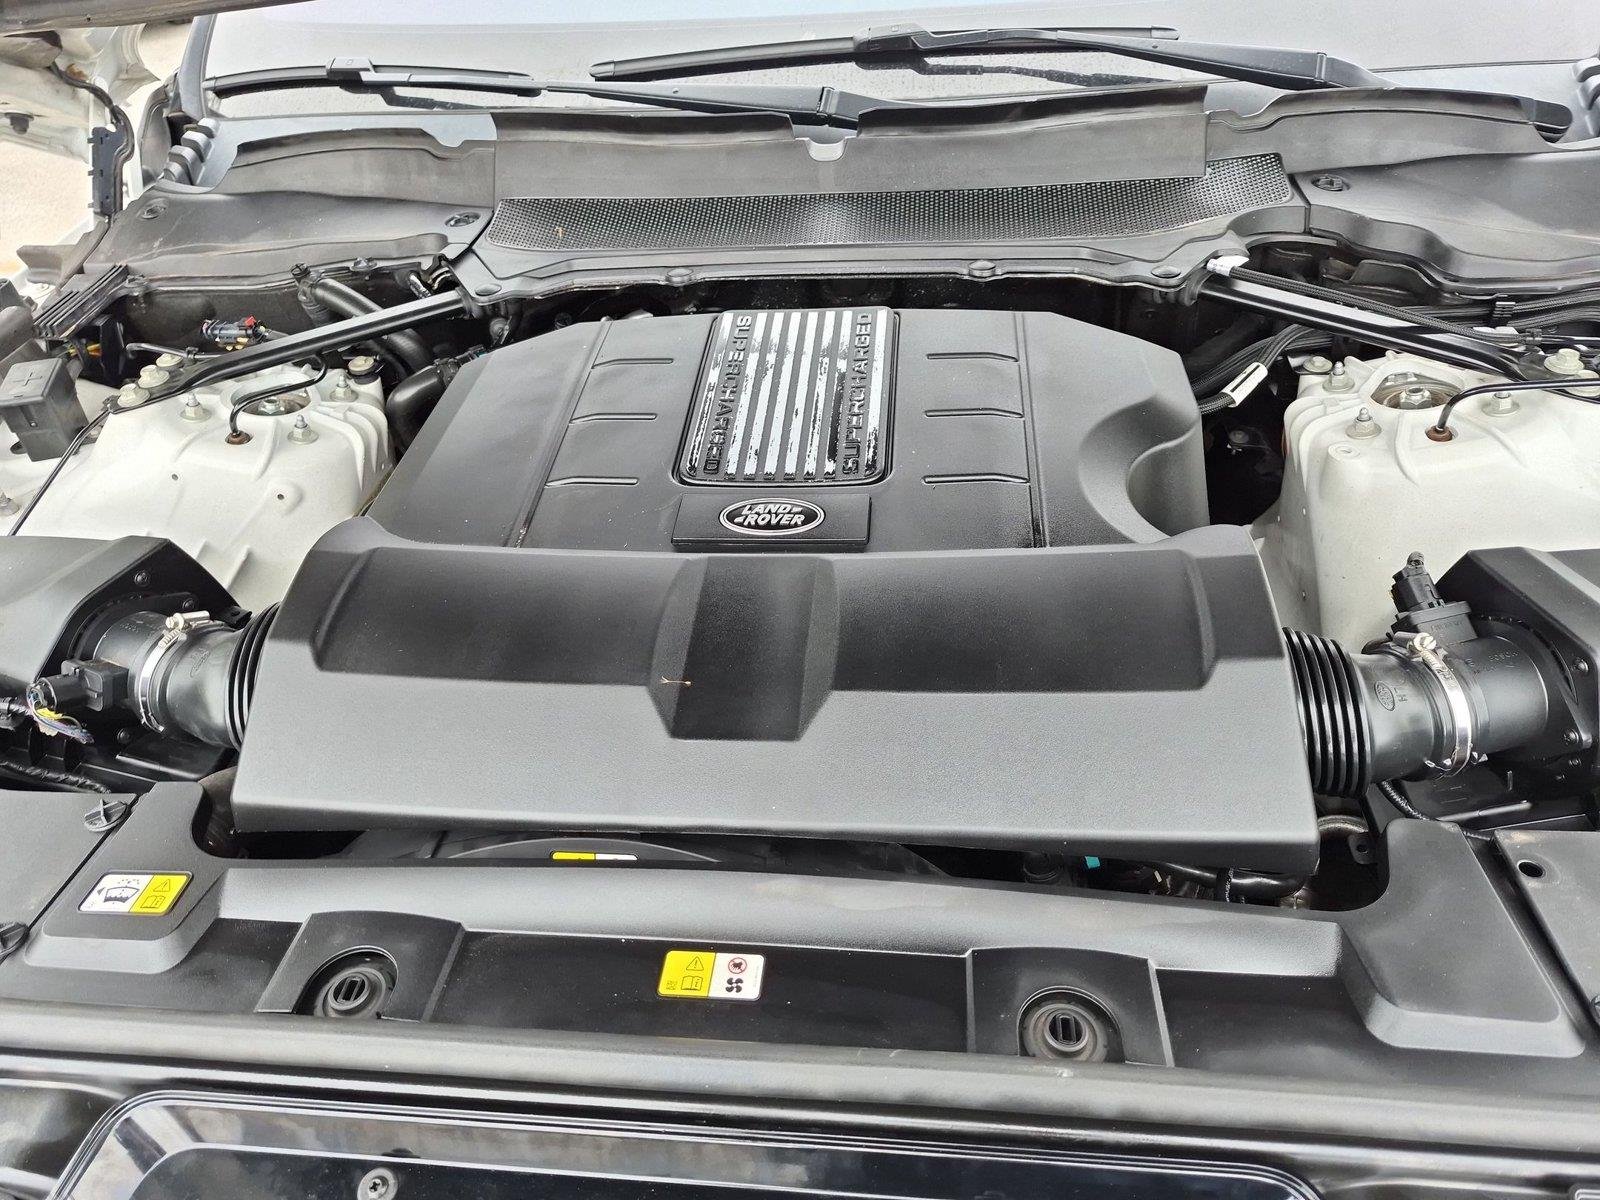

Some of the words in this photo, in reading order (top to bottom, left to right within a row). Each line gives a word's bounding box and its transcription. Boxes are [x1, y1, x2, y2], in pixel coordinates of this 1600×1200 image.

[703, 315, 751, 475] SUPERCHARGED
[842, 312, 872, 475] SUPERCHARGED
[741, 504, 792, 515] LAND
[743, 513, 805, 526] ROVER
